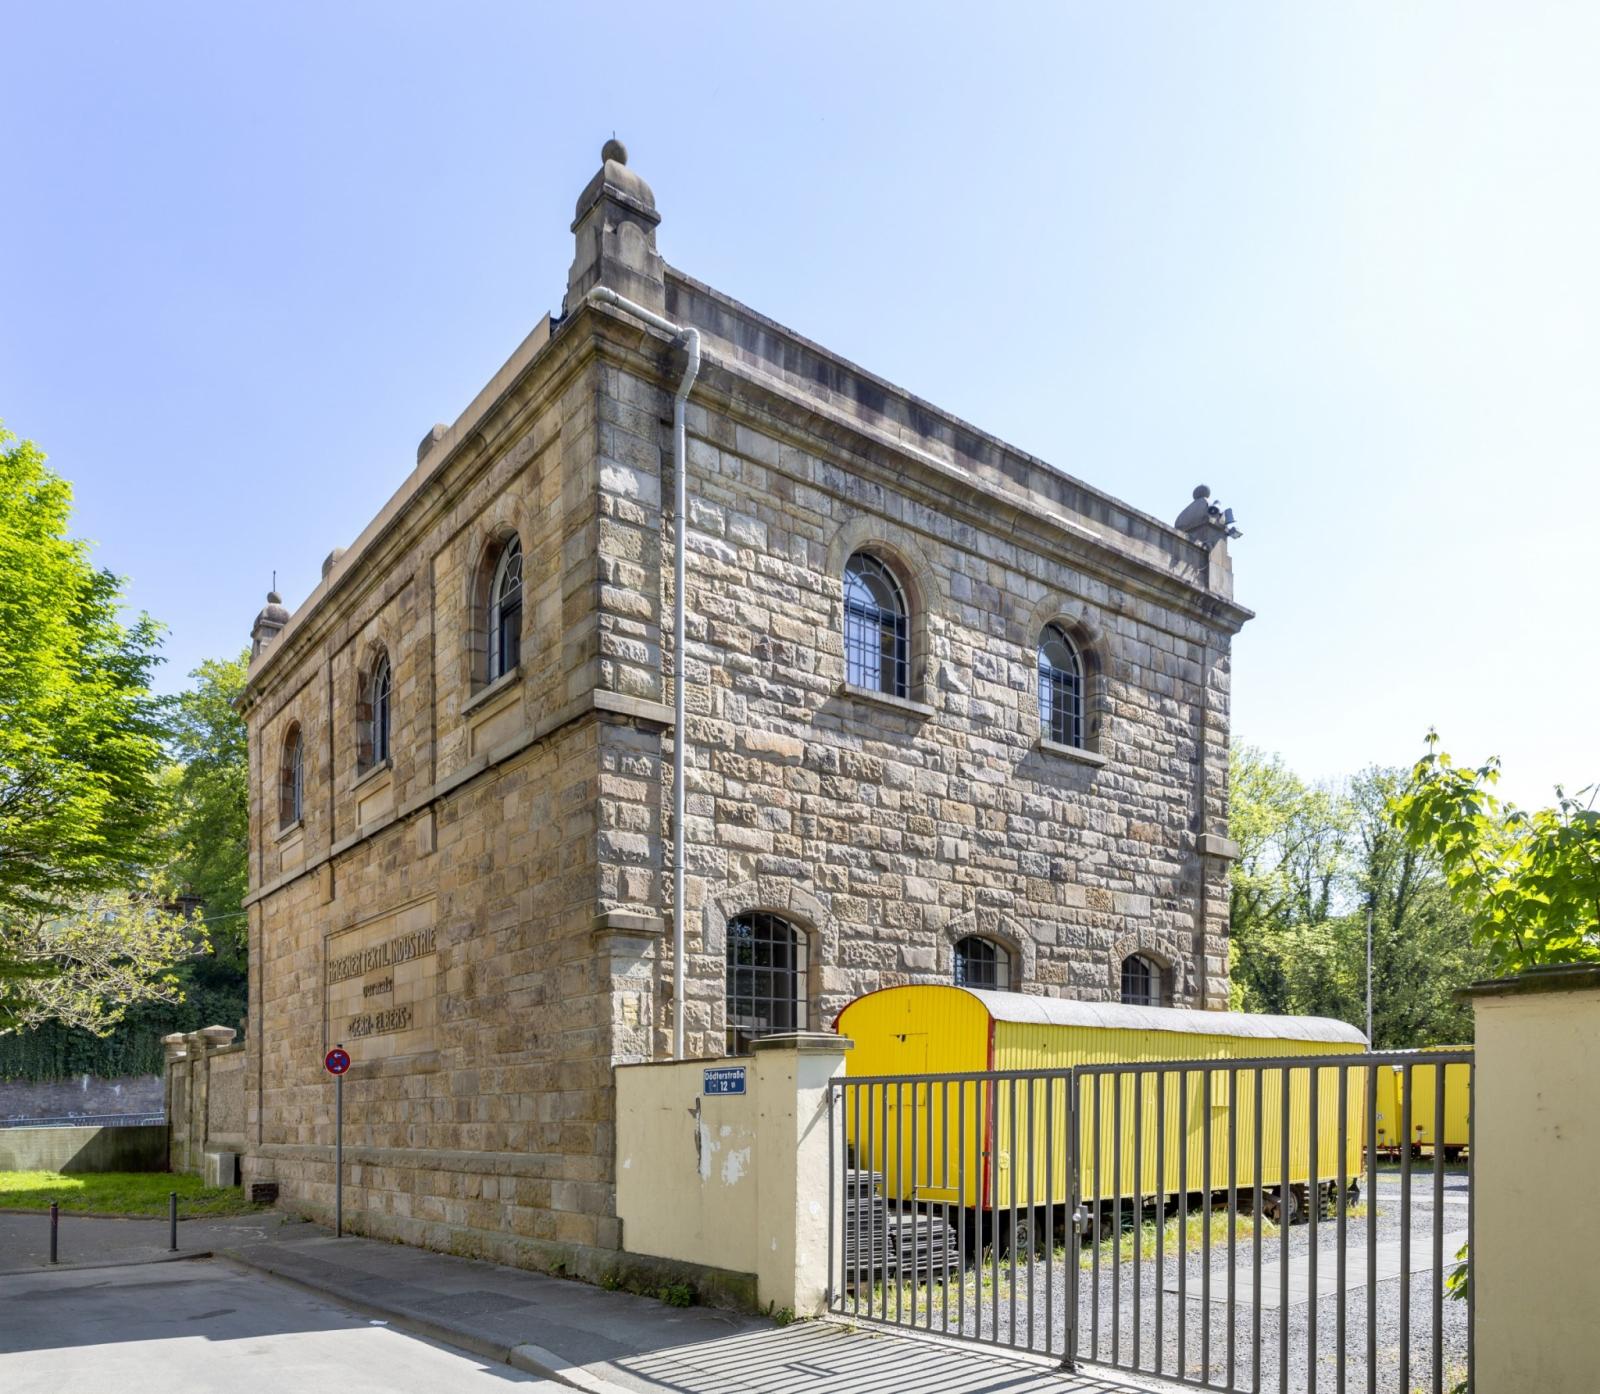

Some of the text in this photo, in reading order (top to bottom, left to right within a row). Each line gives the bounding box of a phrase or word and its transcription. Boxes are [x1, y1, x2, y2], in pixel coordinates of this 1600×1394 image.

[364, 943, 391, 973] TEXTIL
[391, 928, 436, 965] INDUSTRIE
[720, 1081, 728, 1091] 12
